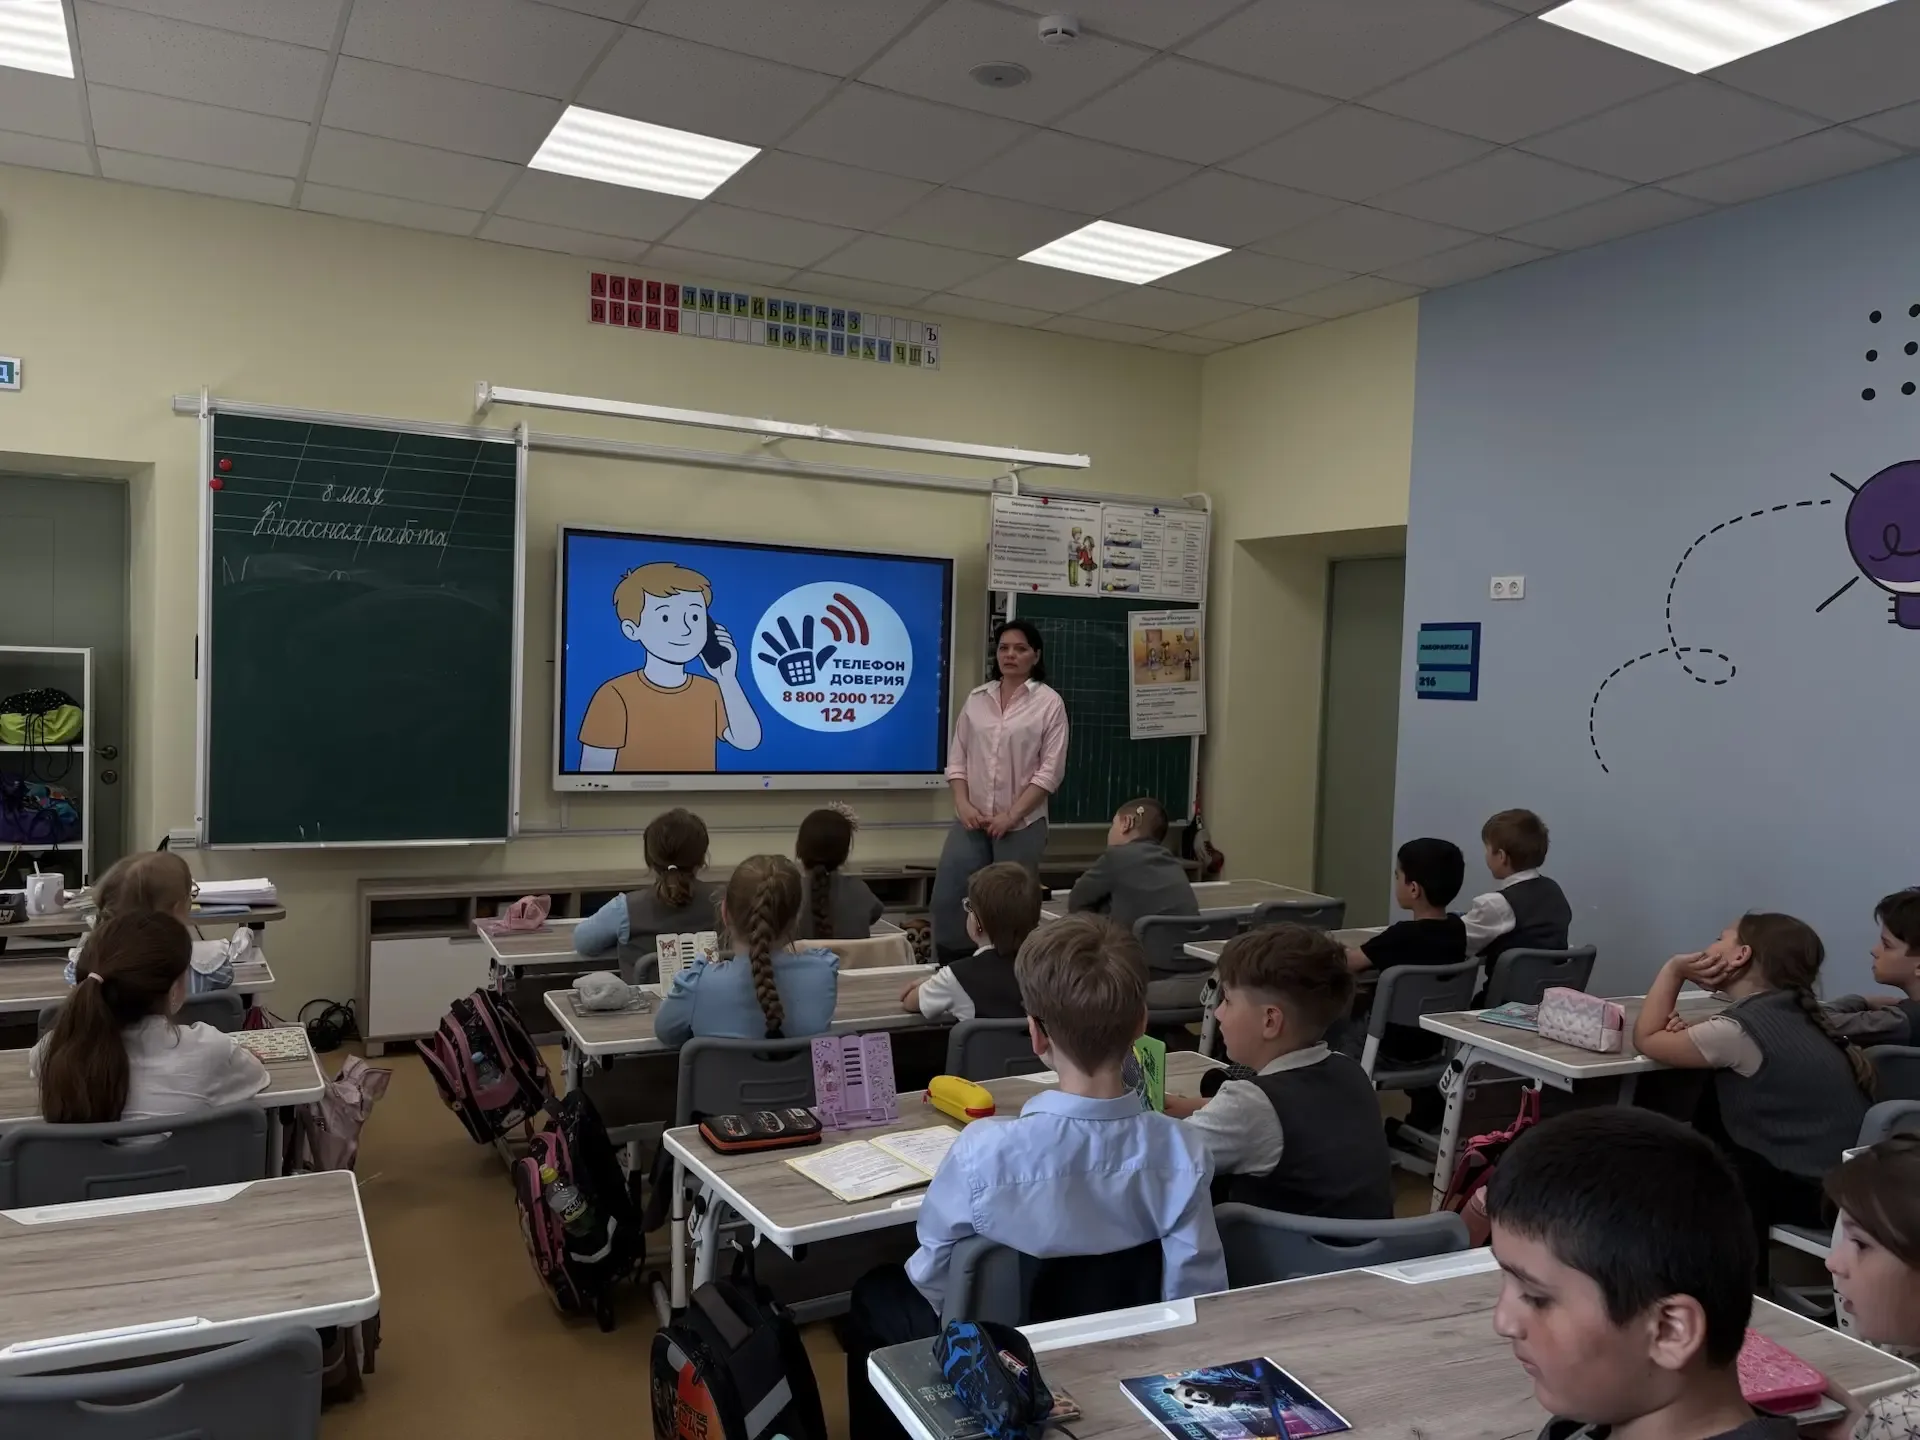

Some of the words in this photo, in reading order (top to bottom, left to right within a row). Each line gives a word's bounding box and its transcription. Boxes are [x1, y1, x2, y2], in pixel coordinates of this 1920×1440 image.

[612, 280, 623, 296] О
[647, 283, 661, 300] Ы
[684, 290, 695, 306] Л
[701, 293, 713, 308] М
[719, 295, 730, 310] Н
[737, 298, 746, 312] Р
[753, 298, 763, 315] Й
[769, 304, 778, 317] Б
[785, 307, 794, 319] В
[802, 308, 809, 322] Г
[817, 311, 826, 326] Д
[832, 312, 845, 327] Ж
[850, 315, 858, 330] З
[926, 327, 937, 341] Ъ
[594, 303, 603, 319] Я
[613, 304, 622, 320] Ё
[648, 310, 658, 326] И
[784, 330, 796, 344] Ф
[800, 332, 810, 346] К
[850, 340, 858, 353] С
[864, 341, 874, 356] Х
[896, 346, 904, 360] Ч
[927, 351, 935, 364] Ь
[322, 484, 333, 502] 8
[336, 485, 385, 506] мая
[253, 500, 363, 541] Классная
[366, 519, 449, 550] работа
[832, 659, 905, 671] ТЕЛЕФОН
[830, 674, 905, 686] ДОВЕРИЯ
[782, 691, 792, 702] 8
[795, 691, 825, 703] 800
[829, 692, 867, 704] 2000
[870, 694, 895, 705] 122
[820, 708, 856, 723] 124
